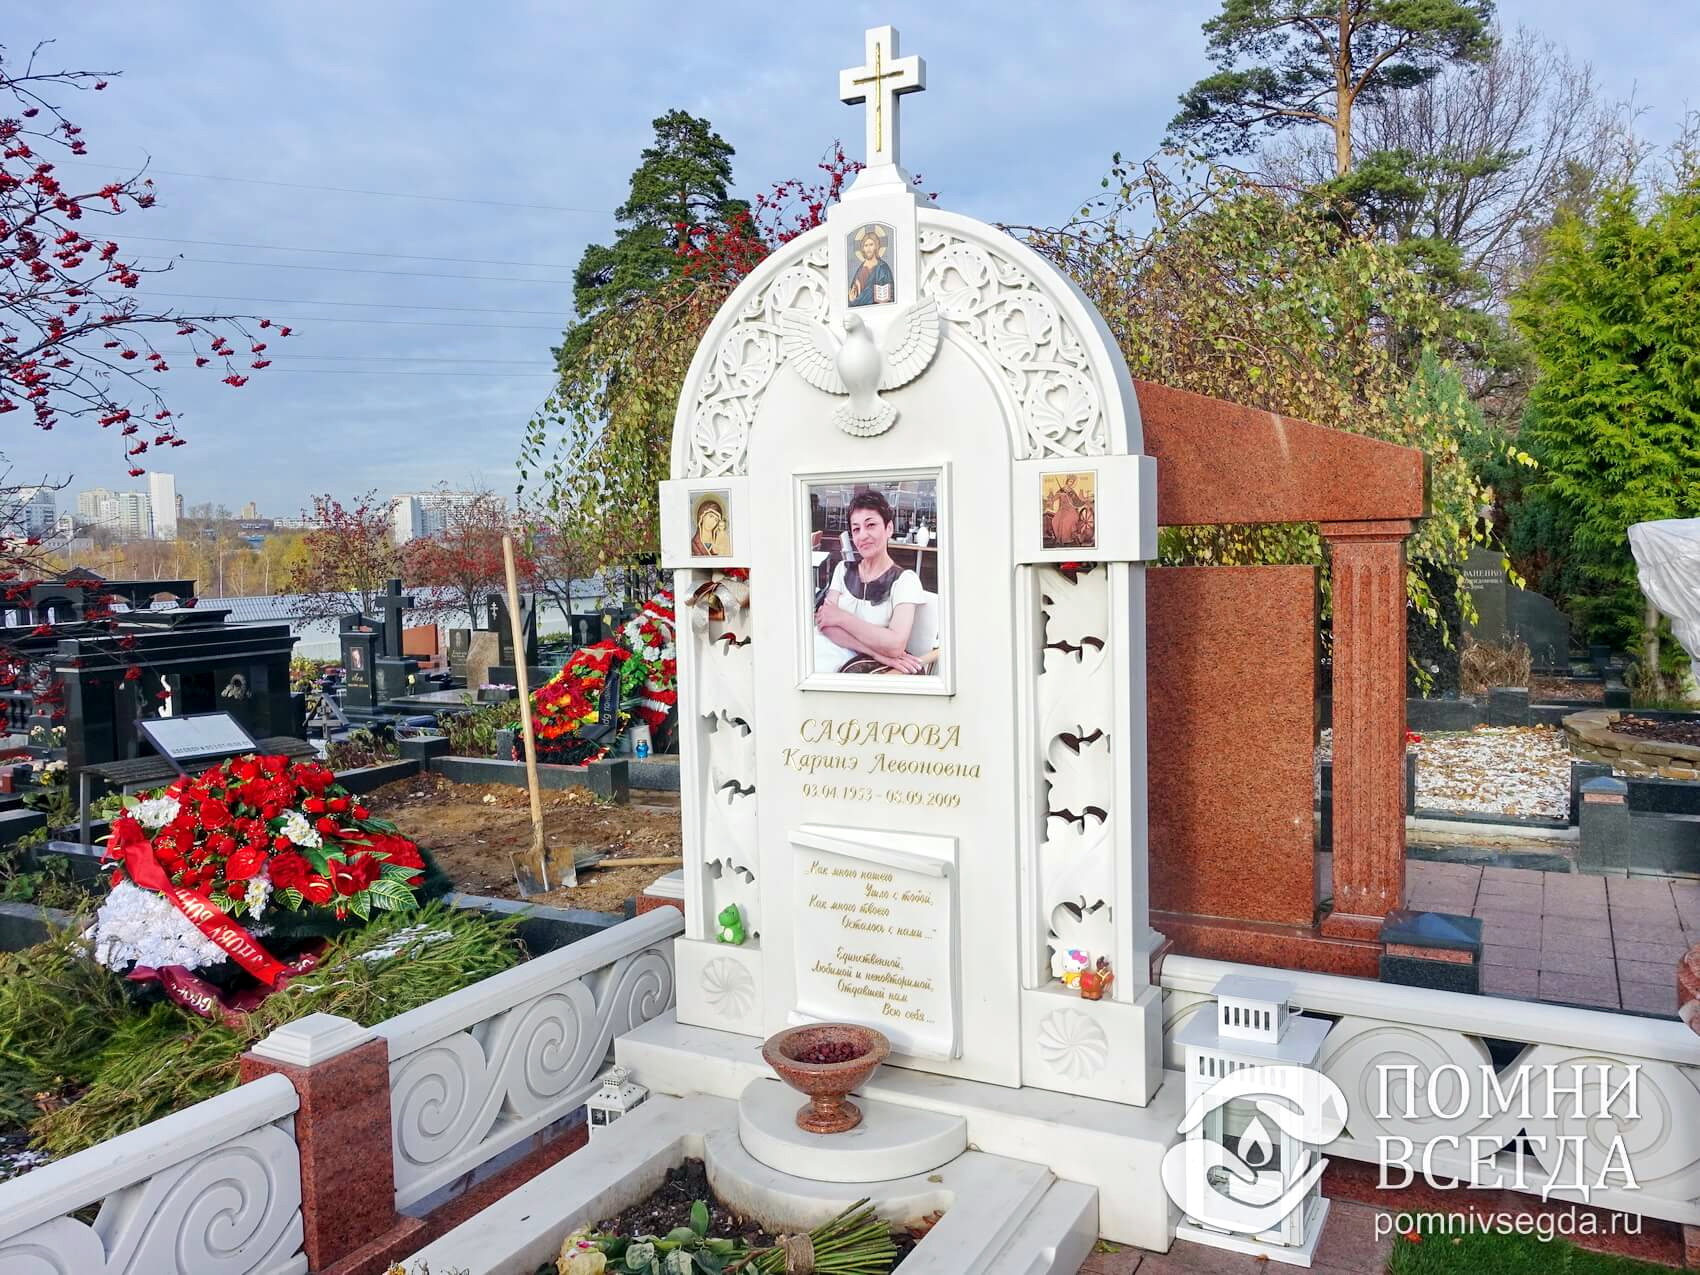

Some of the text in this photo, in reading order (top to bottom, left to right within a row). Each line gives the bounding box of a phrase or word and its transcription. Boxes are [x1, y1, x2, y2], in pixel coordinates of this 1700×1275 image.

[800, 718, 961, 750] САФАРОВА
[782, 748, 982, 778] Каринэ Левоновна
[831, 867, 858, 879] много
[860, 870, 894, 882] нашего
[865, 882, 889, 899] Ушло
[808, 894, 890, 917] Как много твоего
[841, 914, 886, 933] Осталось
[811, 960, 853, 978] Любимой
[855, 971, 862, 980] и
[837, 979, 909, 1002] Отдавшей нам
[881, 1002, 901, 1017] Всю
